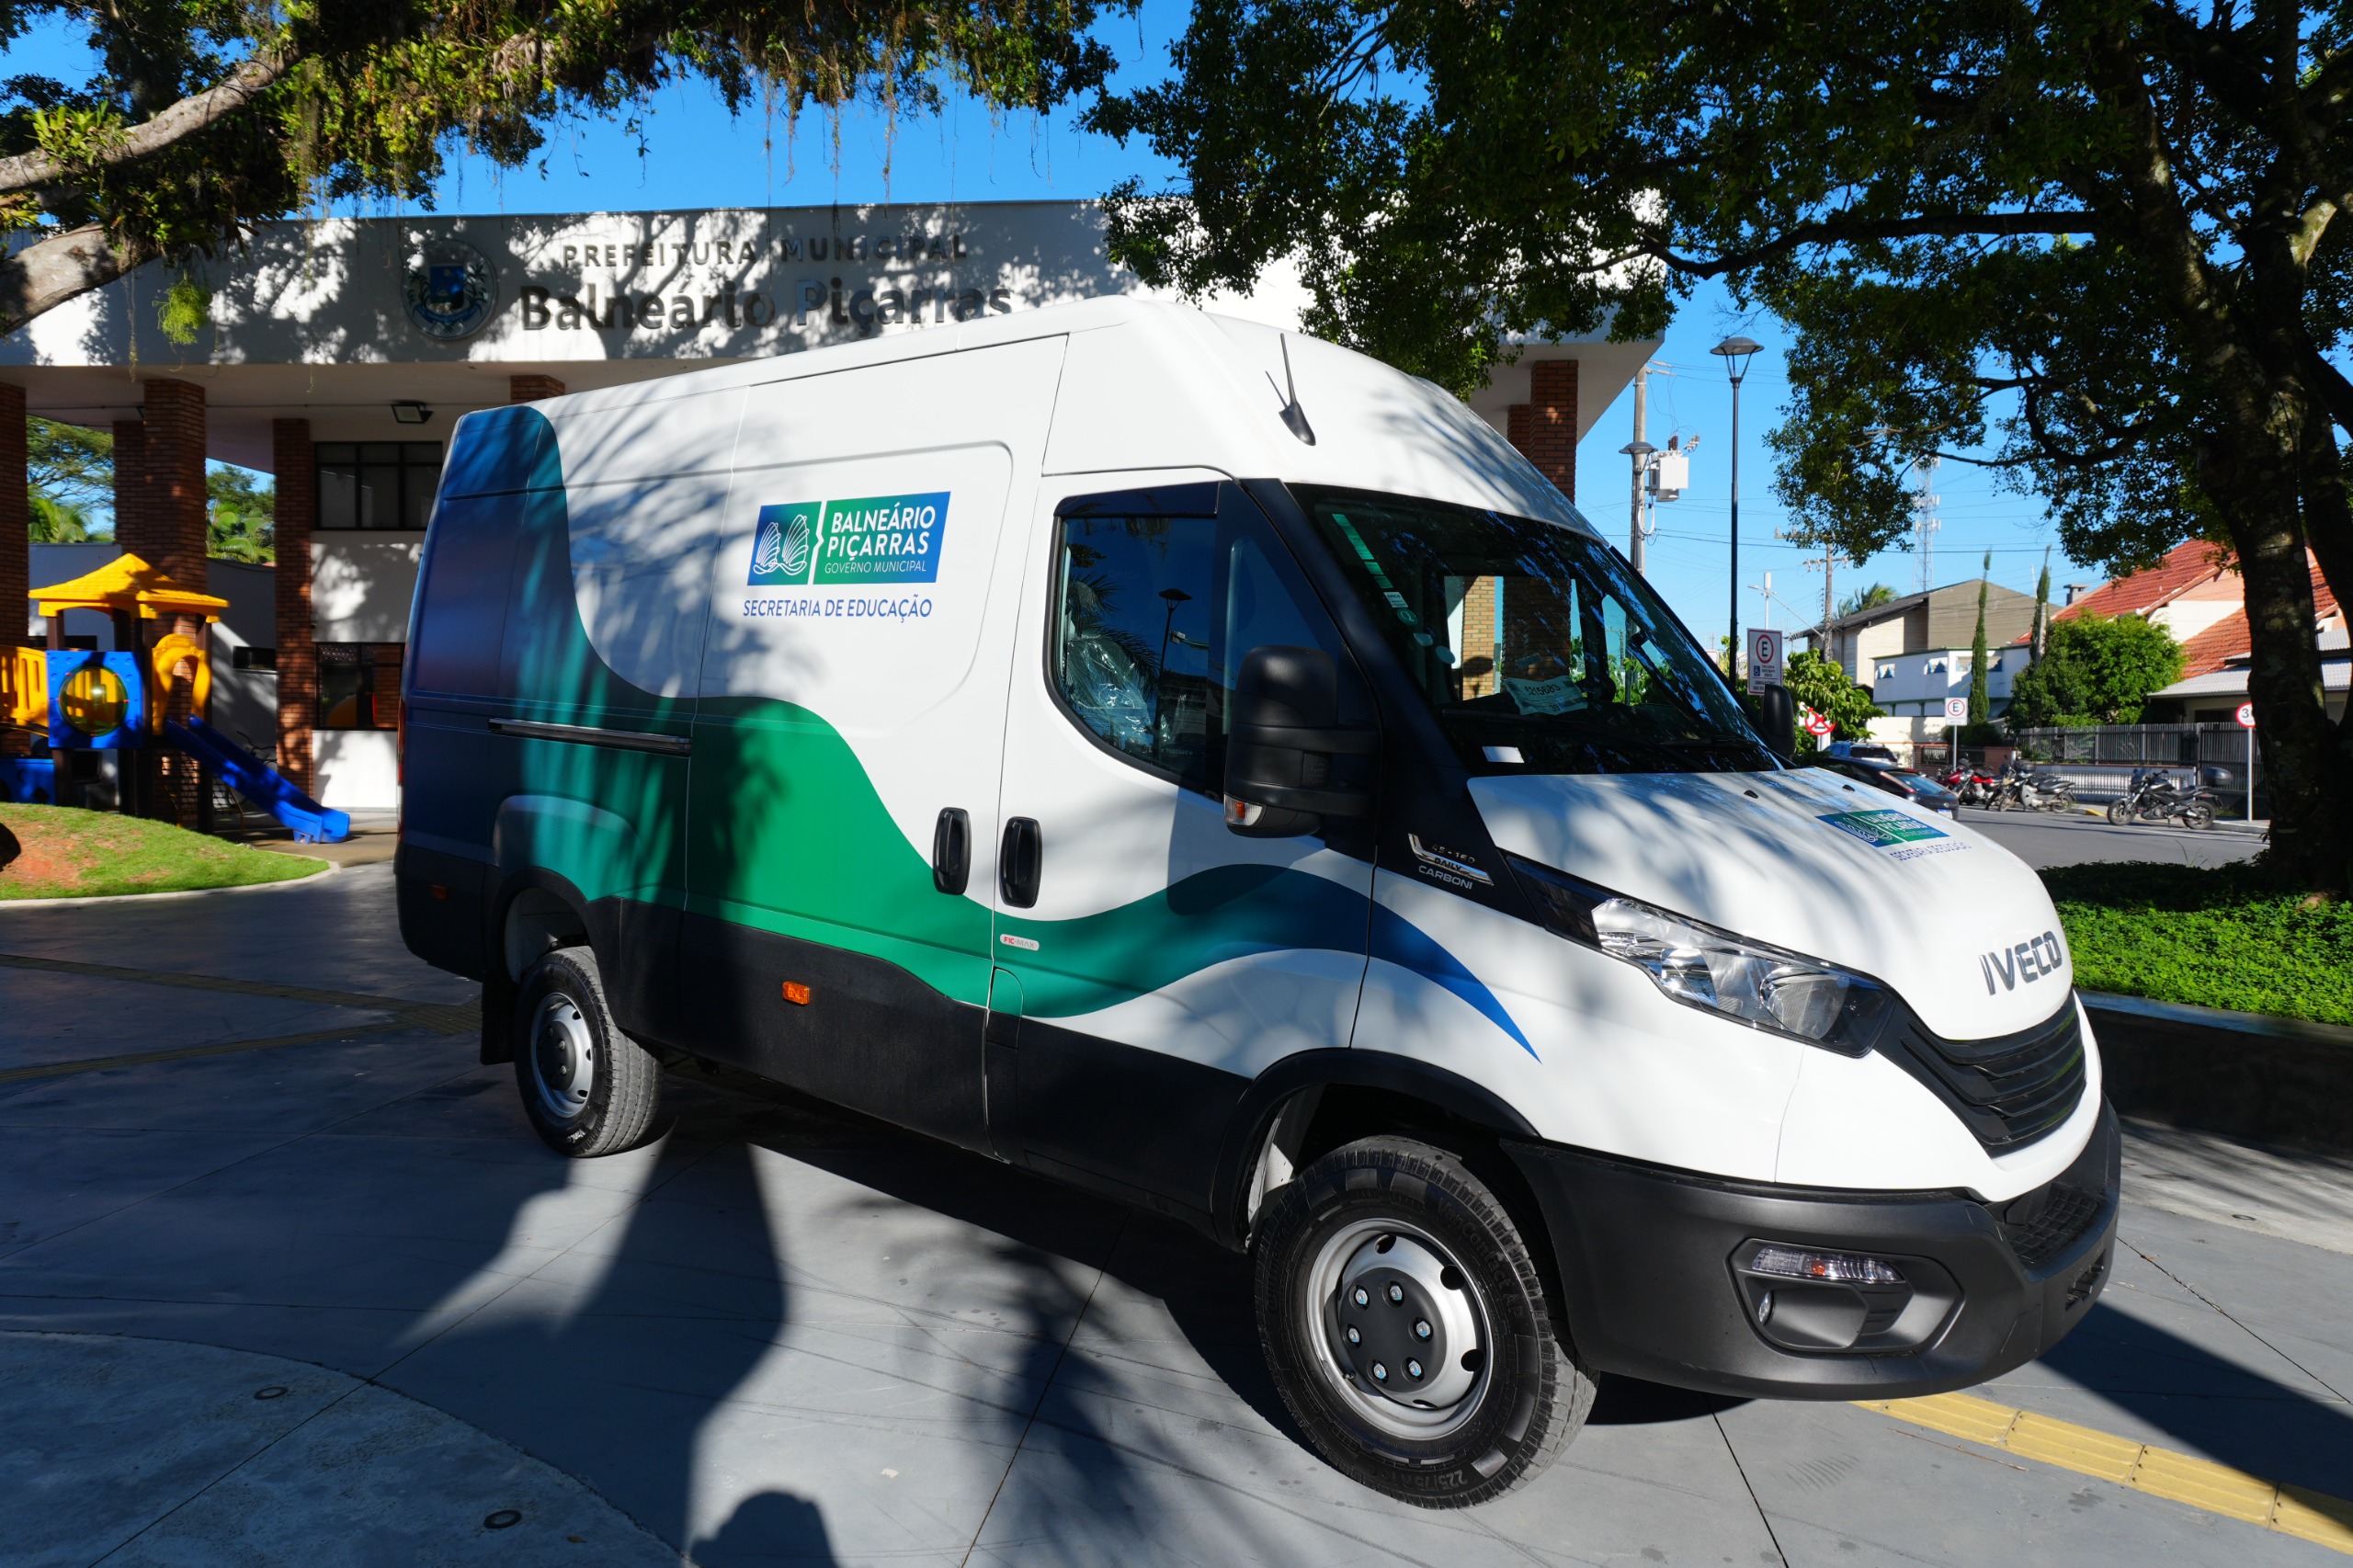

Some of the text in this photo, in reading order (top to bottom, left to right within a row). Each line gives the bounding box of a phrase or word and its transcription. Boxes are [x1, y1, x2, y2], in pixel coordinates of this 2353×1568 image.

[562, 235, 967, 267] PREFEITURA MUNICIPAL
[520, 277, 1012, 338] Balneário Piçarras
[831, 502, 936, 534] BALNEÁRIO
[826, 531, 930, 562] PIÇARRAS
[824, 560, 927, 574] GOVERNO MUNICIPAL
[743, 593, 933, 624] SECRETARIA DE EDUCAÇÃO
[1761, 641, 1768, 657] E
[1952, 701, 1960, 712] E
[2242, 708, 2249, 719] 3
[1418, 865, 1474, 890] CARBONI
[1434, 856, 1462, 871] DAILY
[1978, 930, 2063, 996] IVECO
[1438, 1197, 1513, 1290] VanContact
